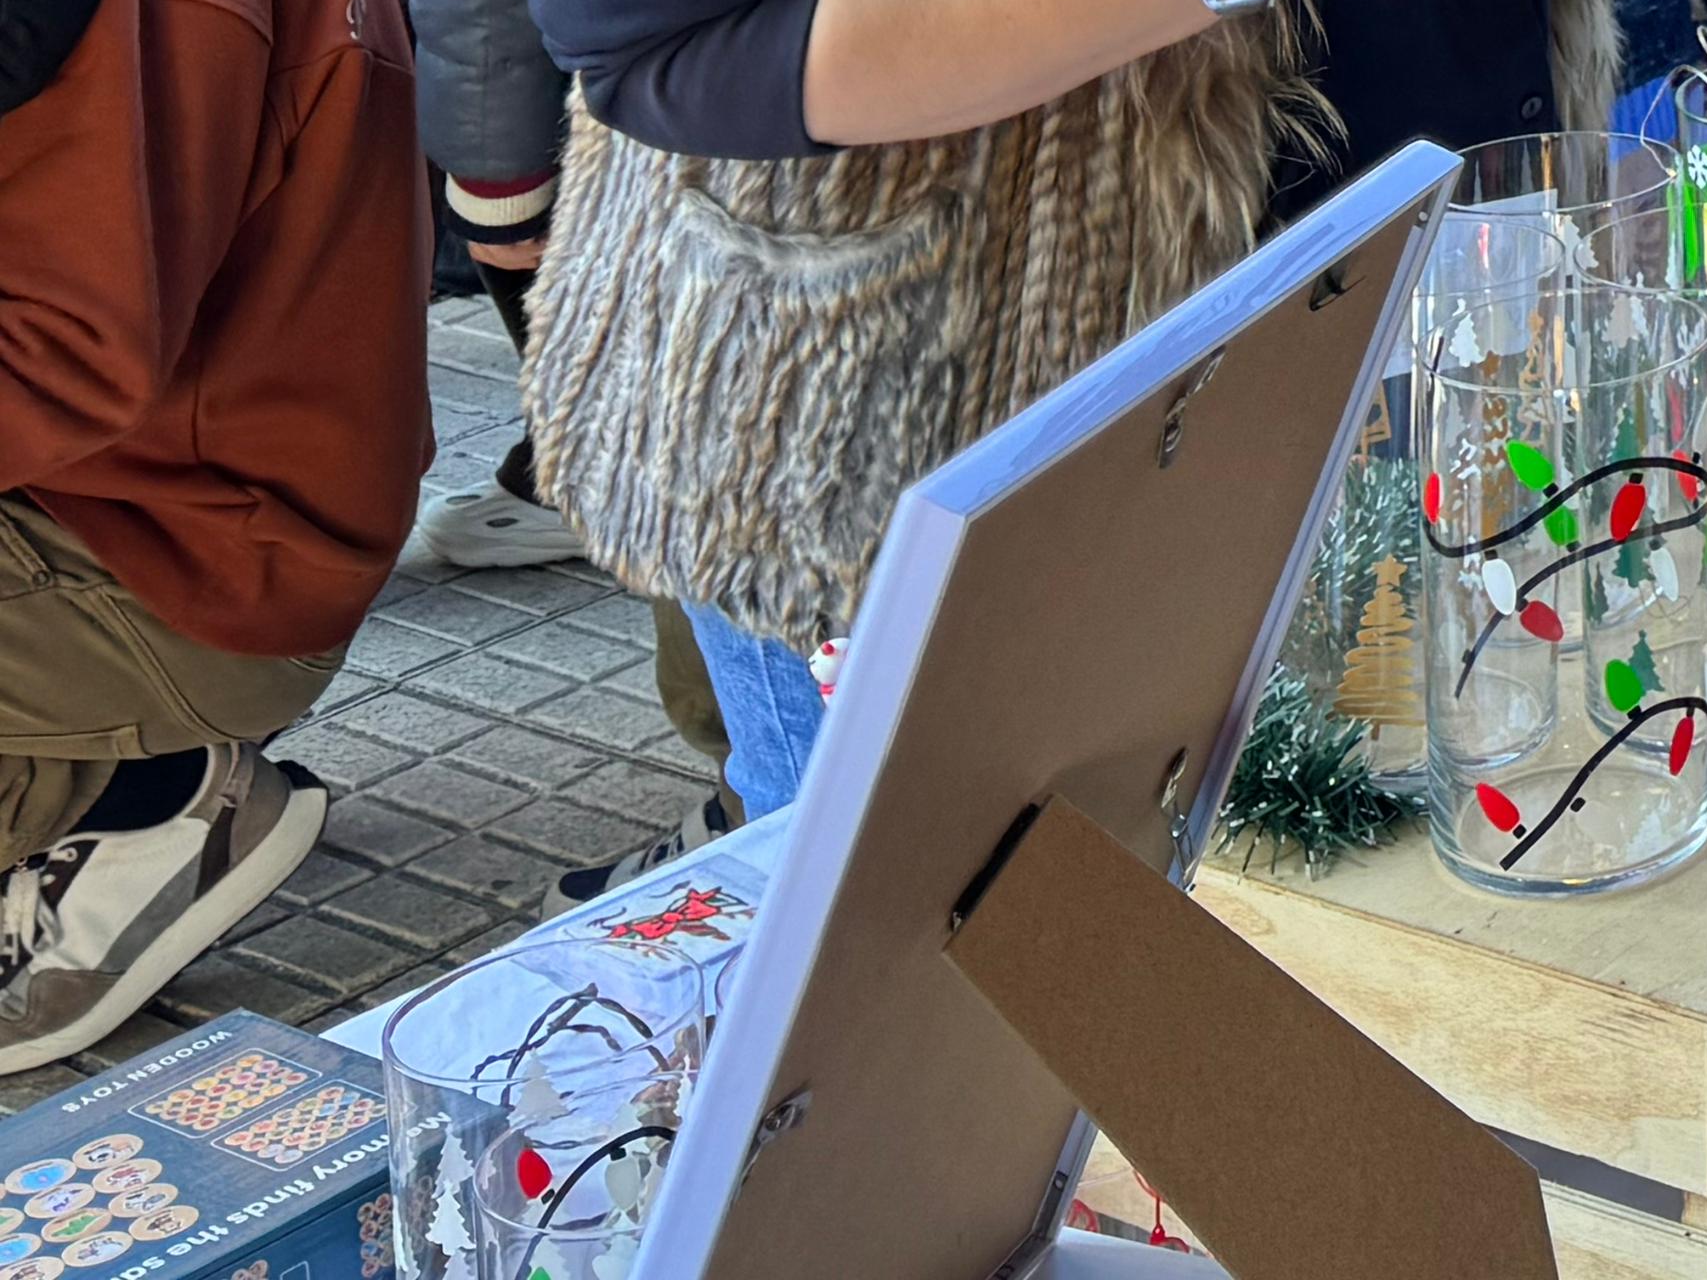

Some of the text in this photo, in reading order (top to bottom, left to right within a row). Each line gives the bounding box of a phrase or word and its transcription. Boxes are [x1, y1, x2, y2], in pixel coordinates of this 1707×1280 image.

[61, 1030, 233, 1113] WOODEN TOYS
[226, 1179, 316, 1226] finds
[166, 1224, 230, 1257] the
